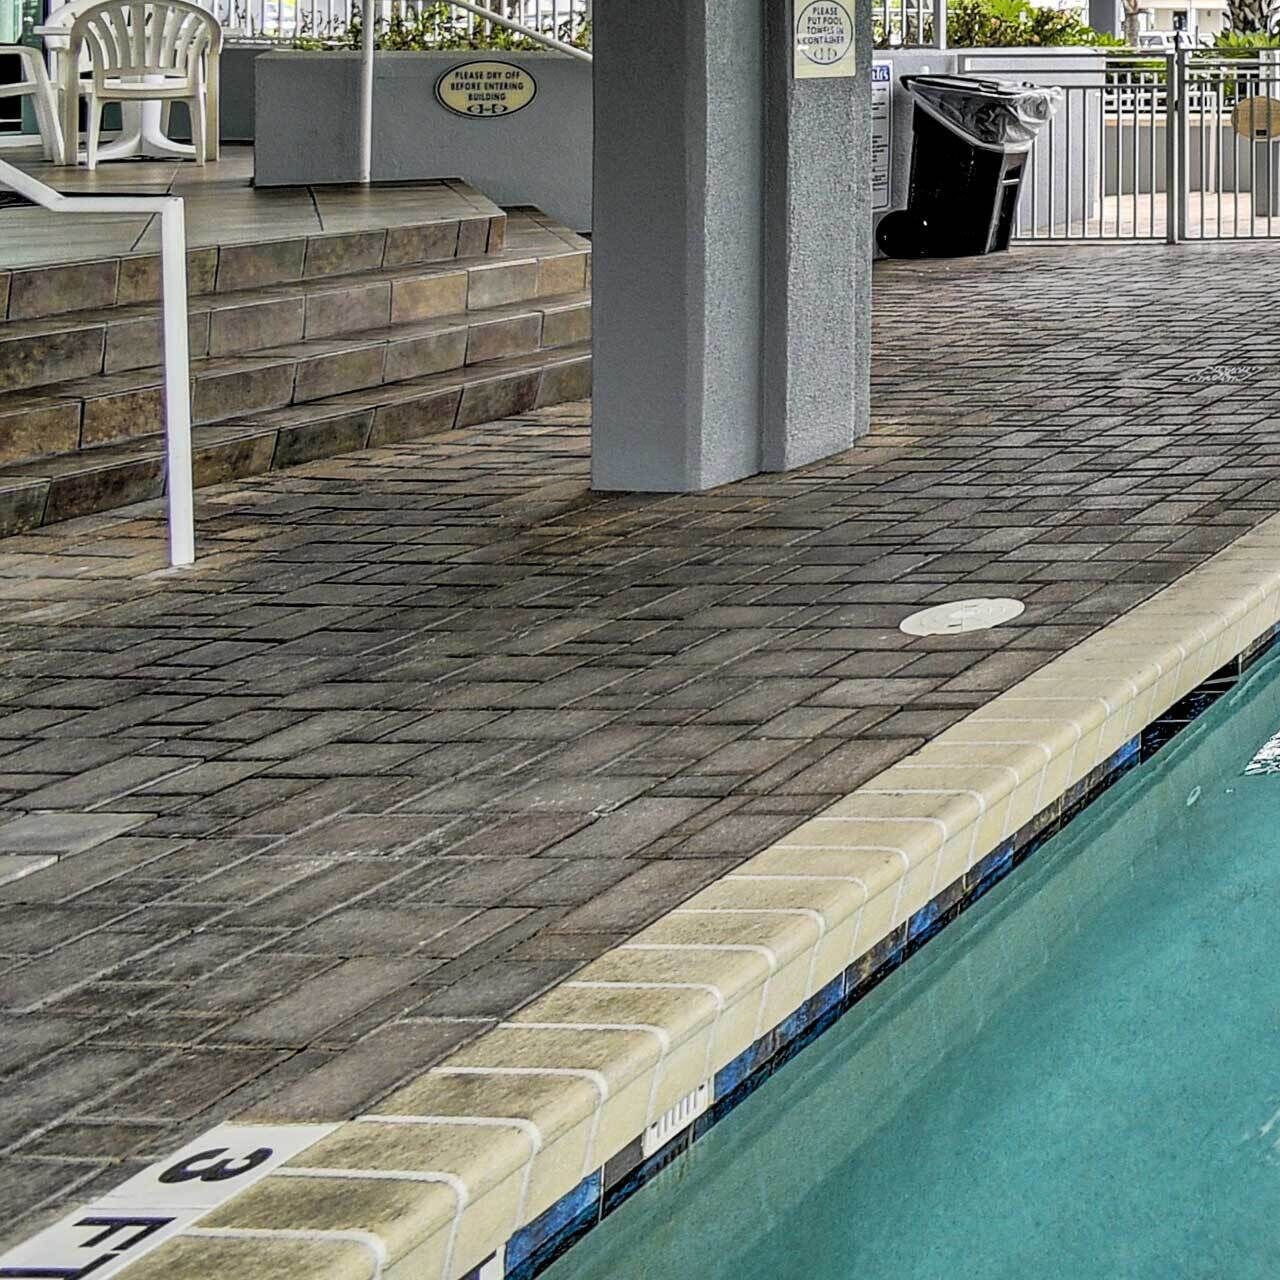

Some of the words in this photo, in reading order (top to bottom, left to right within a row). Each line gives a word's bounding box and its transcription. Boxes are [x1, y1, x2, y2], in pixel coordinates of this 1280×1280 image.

[812, 7, 838, 16] PLEASE
[808, 17, 821, 25] PUT
[823, 17, 842, 25] POOL
[455, 71, 483, 80] PLEASE
[486, 71, 502, 80] DRY
[505, 71, 520, 80] OFF
[450, 82, 480, 91] BEFORE
[484, 82, 524, 91] ENTERING
[468, 93, 506, 101] BUILDING
[158, 1147, 274, 1184] 3
